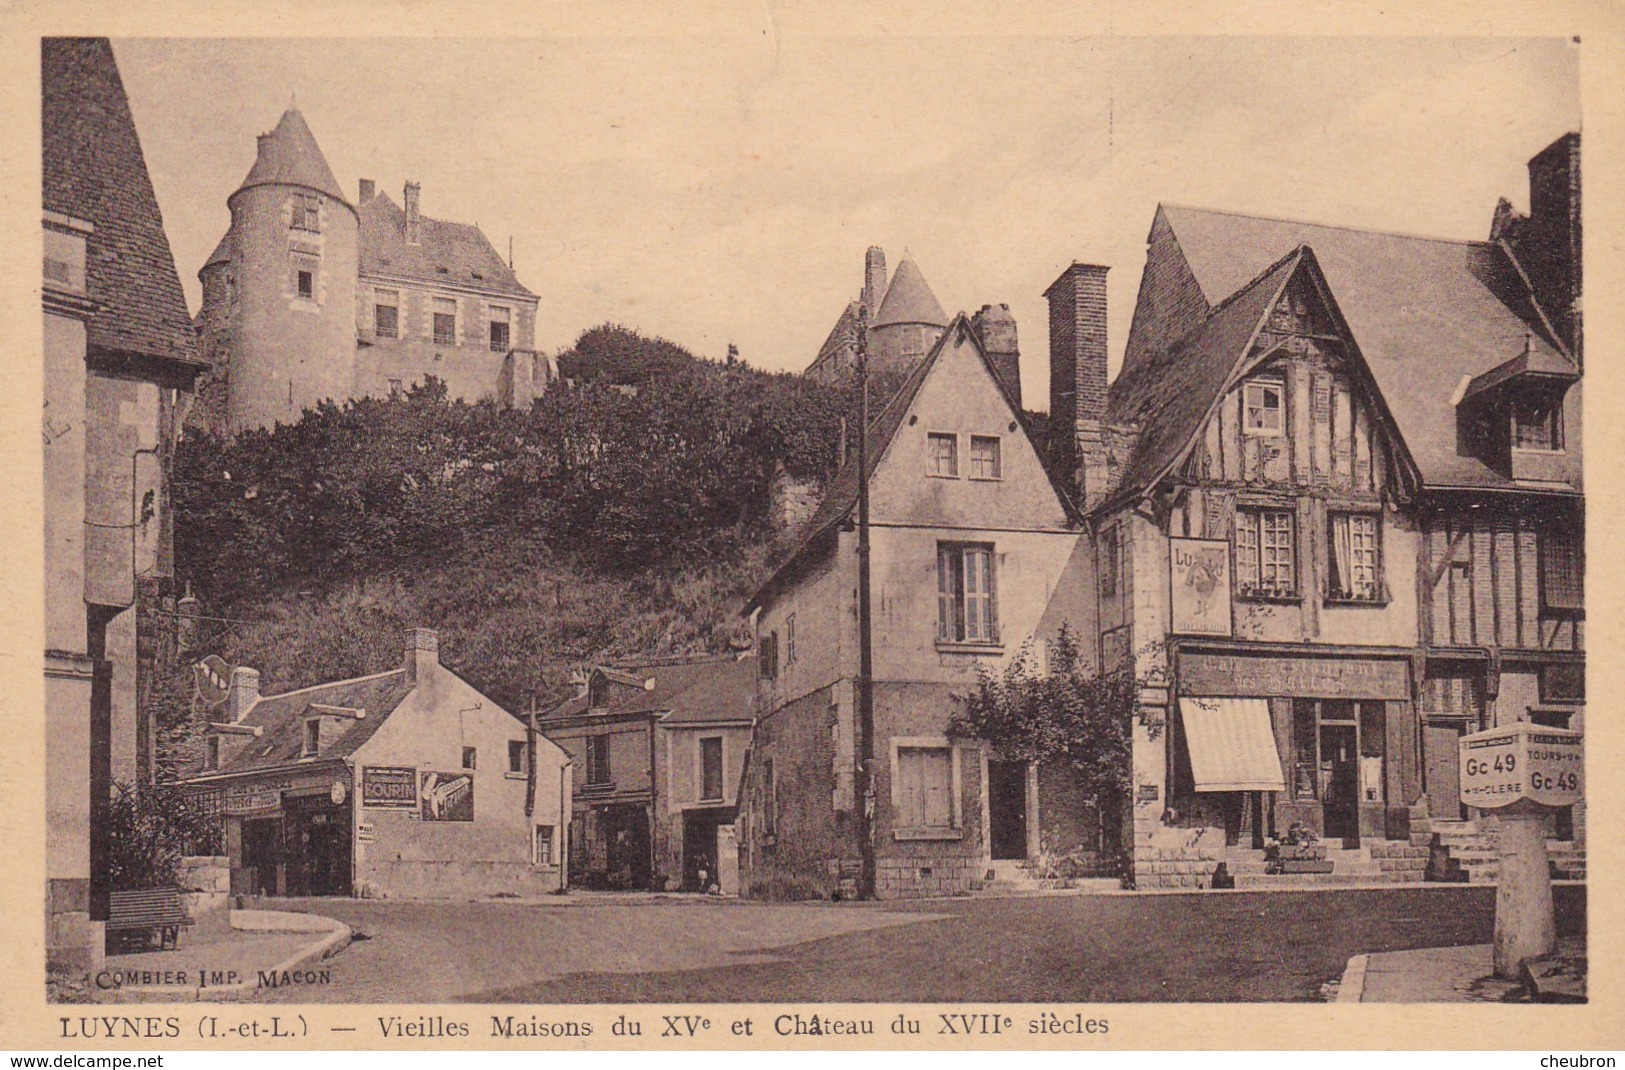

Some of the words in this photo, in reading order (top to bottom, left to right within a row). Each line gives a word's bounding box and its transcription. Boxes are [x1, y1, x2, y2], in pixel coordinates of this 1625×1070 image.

[1175, 548, 1192, 567] LU
[1466, 758, 1488, 776] Gc
[1494, 753, 1516, 773] 49
[1527, 750, 1560, 761] TOURS
[1531, 771, 1553, 790] Gc
[1557, 772, 1578, 791] 49
